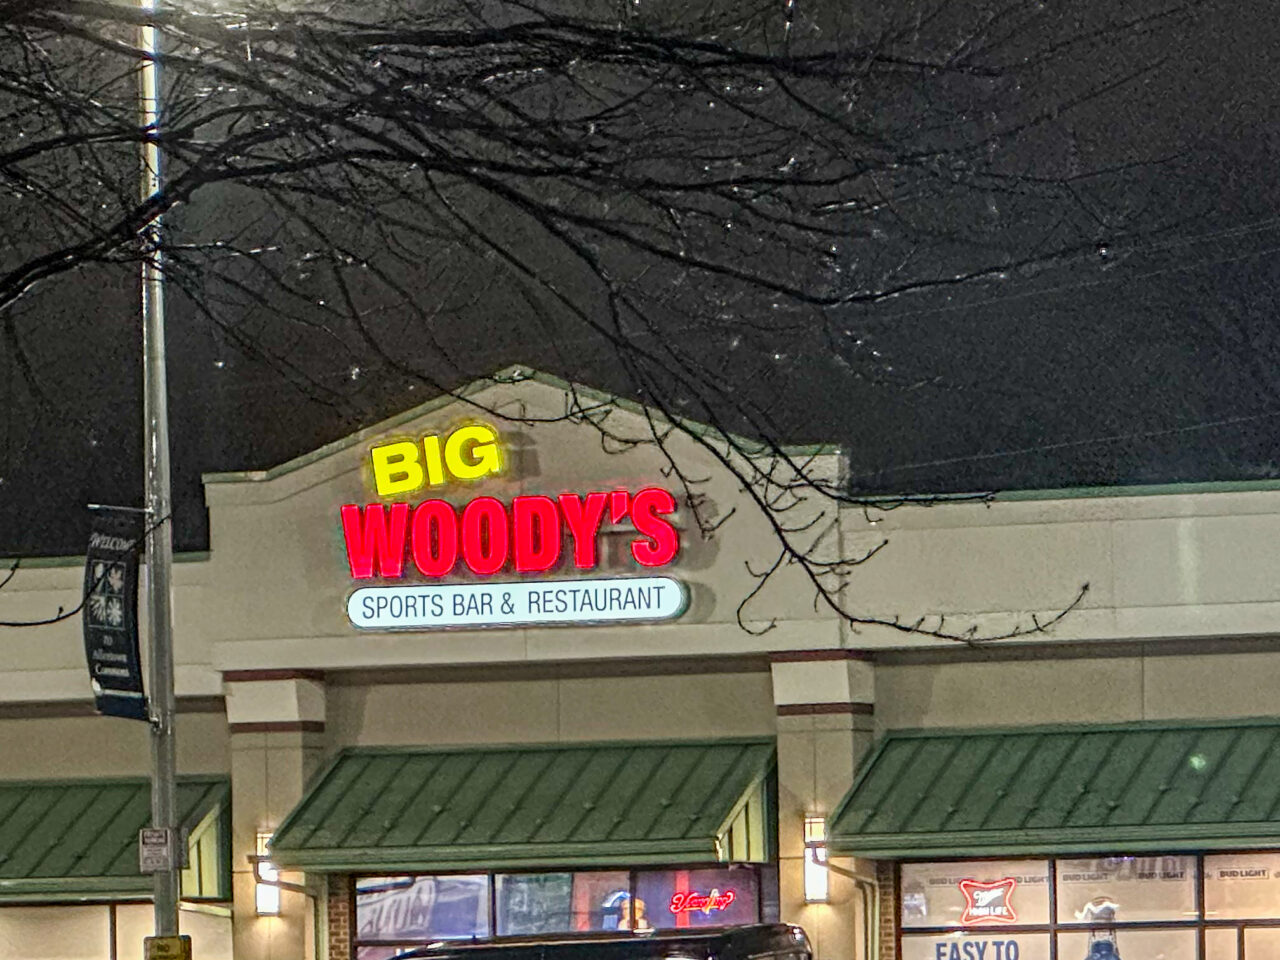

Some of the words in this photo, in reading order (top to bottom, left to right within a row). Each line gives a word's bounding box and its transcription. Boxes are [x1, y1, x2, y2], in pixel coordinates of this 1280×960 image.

[371, 425, 500, 496] BIG
[341, 488, 679, 578] WOODY'S
[362, 594, 444, 619] SPORTS
[453, 592, 493, 616] BAR
[500, 590, 515, 614] &
[528, 586, 665, 613] RESTAURANT
